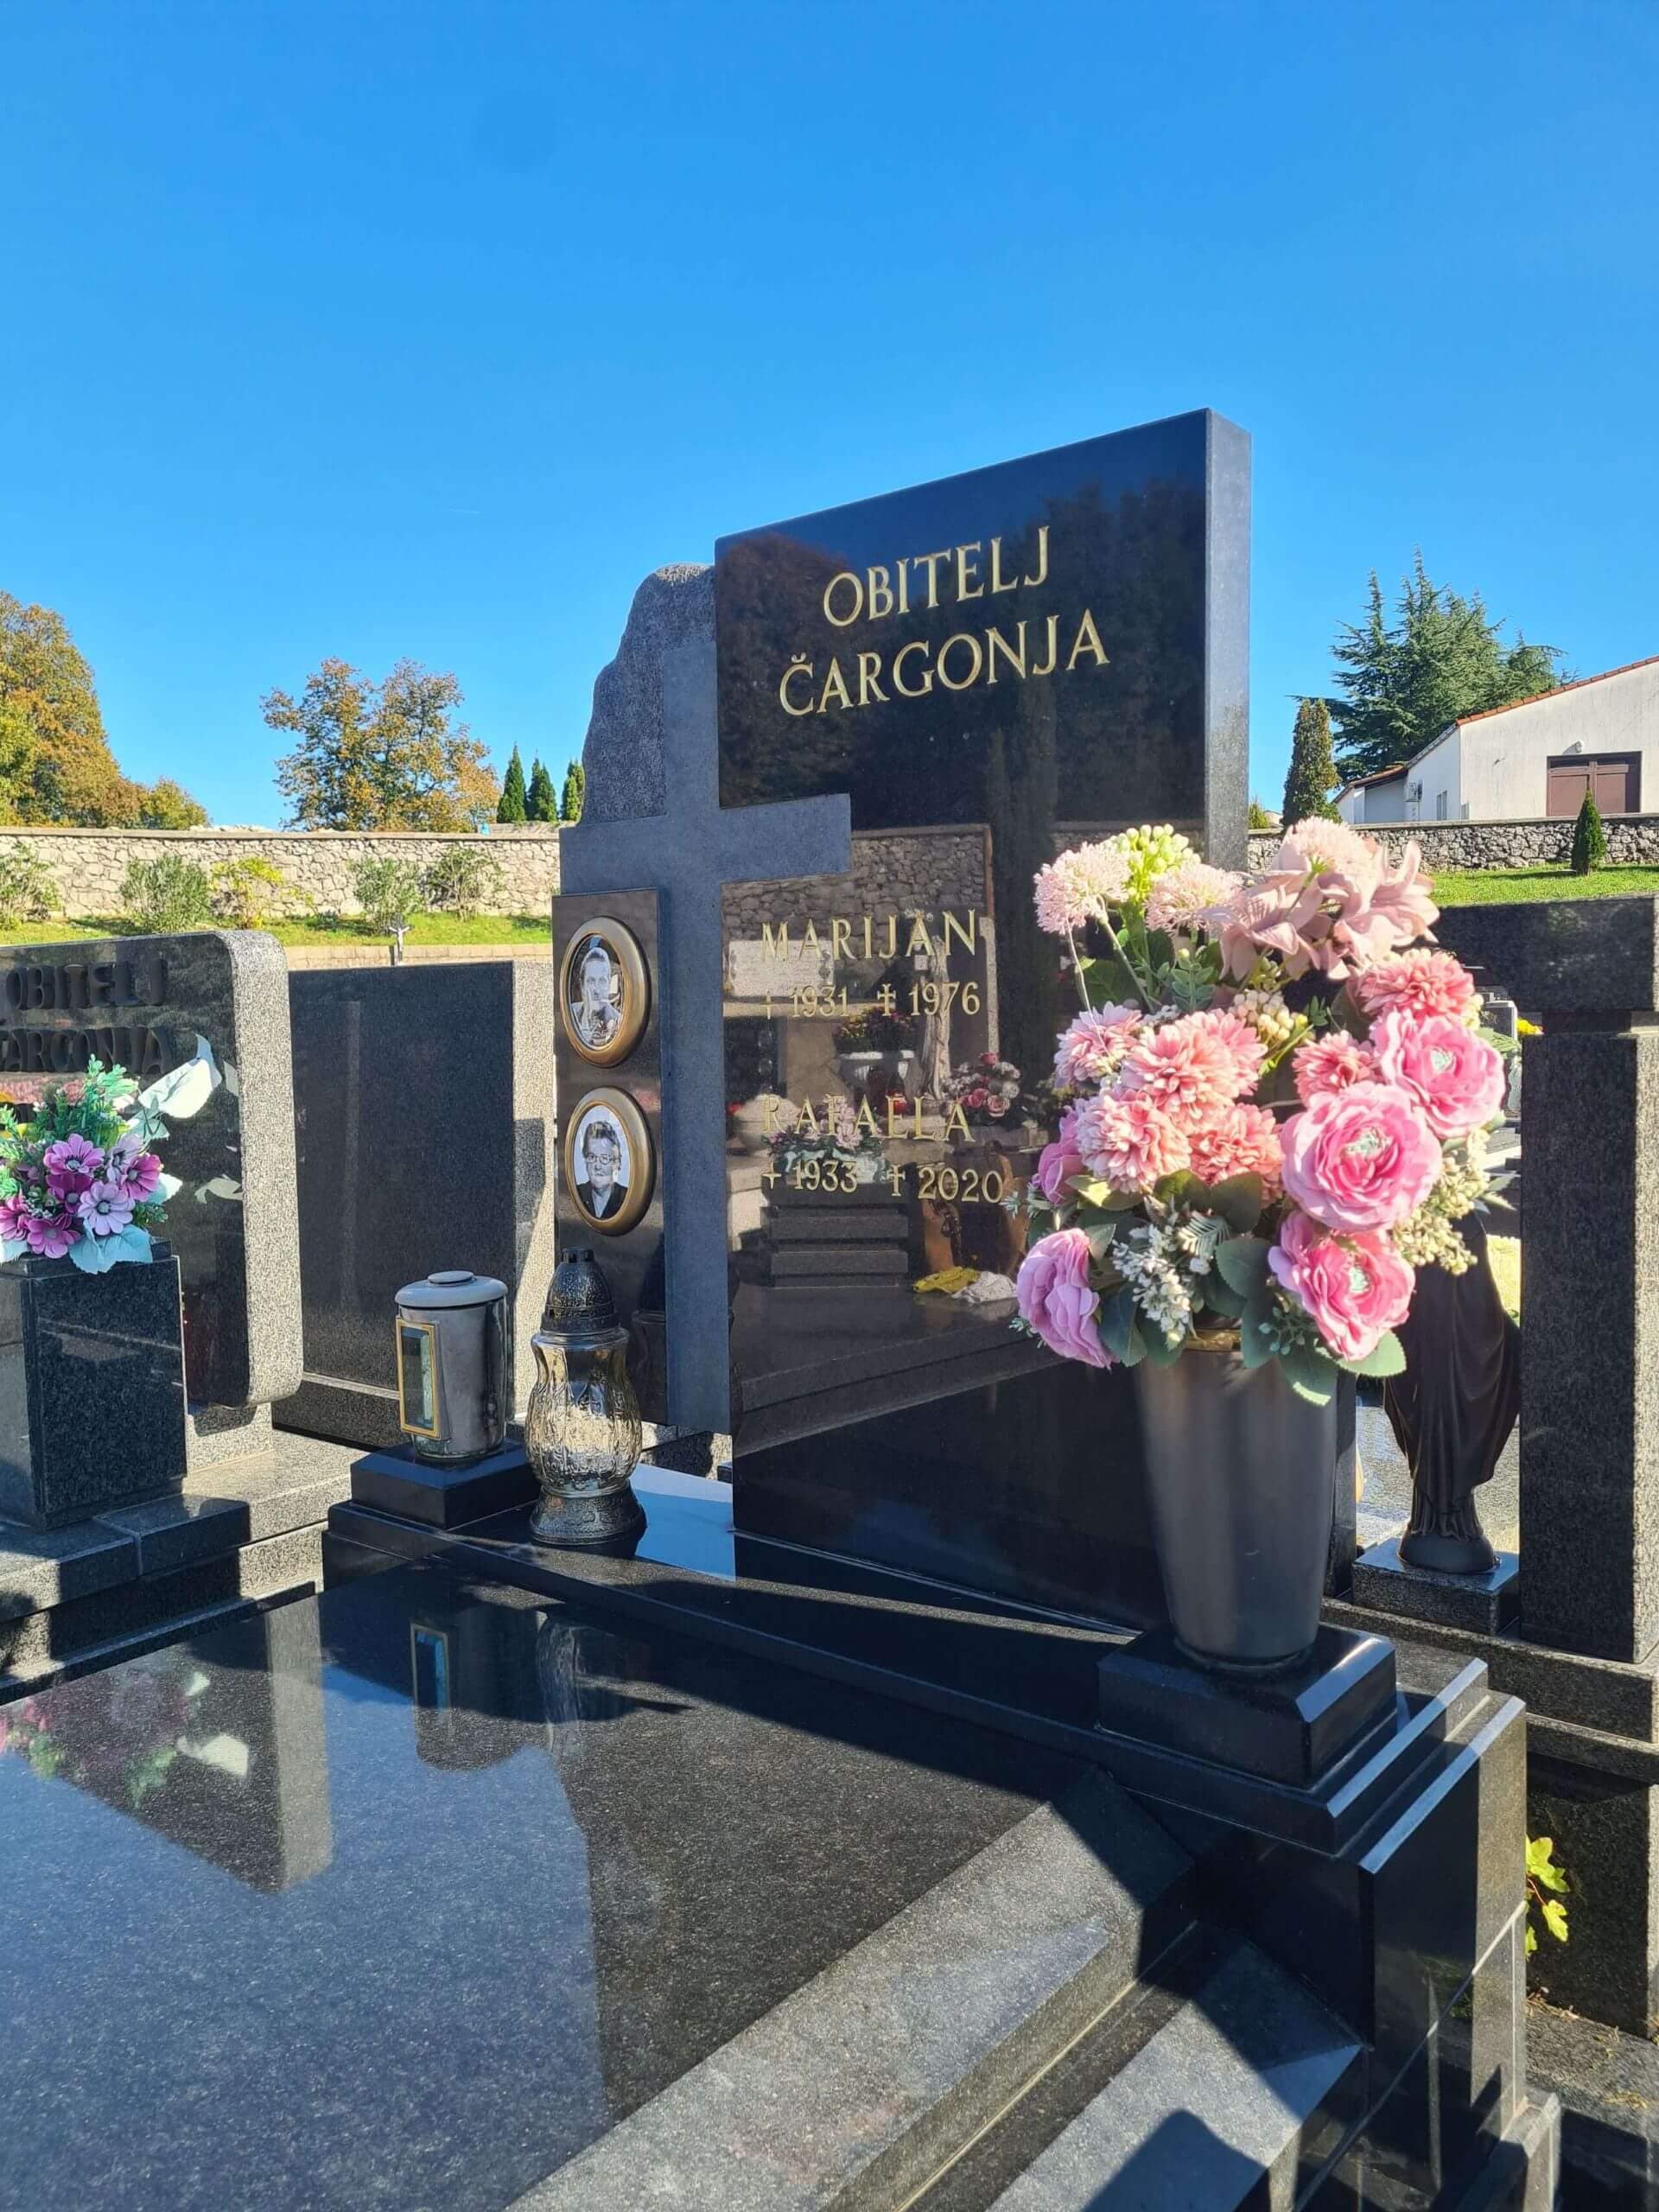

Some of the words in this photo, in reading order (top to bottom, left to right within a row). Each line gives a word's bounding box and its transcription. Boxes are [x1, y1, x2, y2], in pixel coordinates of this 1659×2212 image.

[823, 524, 1050, 627] OBITELJ
[779, 607, 1110, 716] ČARGONJA
[760, 908, 976, 962] MARIJAN
[6, 958, 168, 1010] OBITELJ
[789, 985, 850, 1018] 1931
[908, 982, 981, 1017] 1976
[0, 1023, 172, 1074] ARGONJA
[761, 1093, 976, 1143] RAFAELA
[793, 1160, 858, 1193] 1933
[918, 1166, 1004, 1204] 2020
